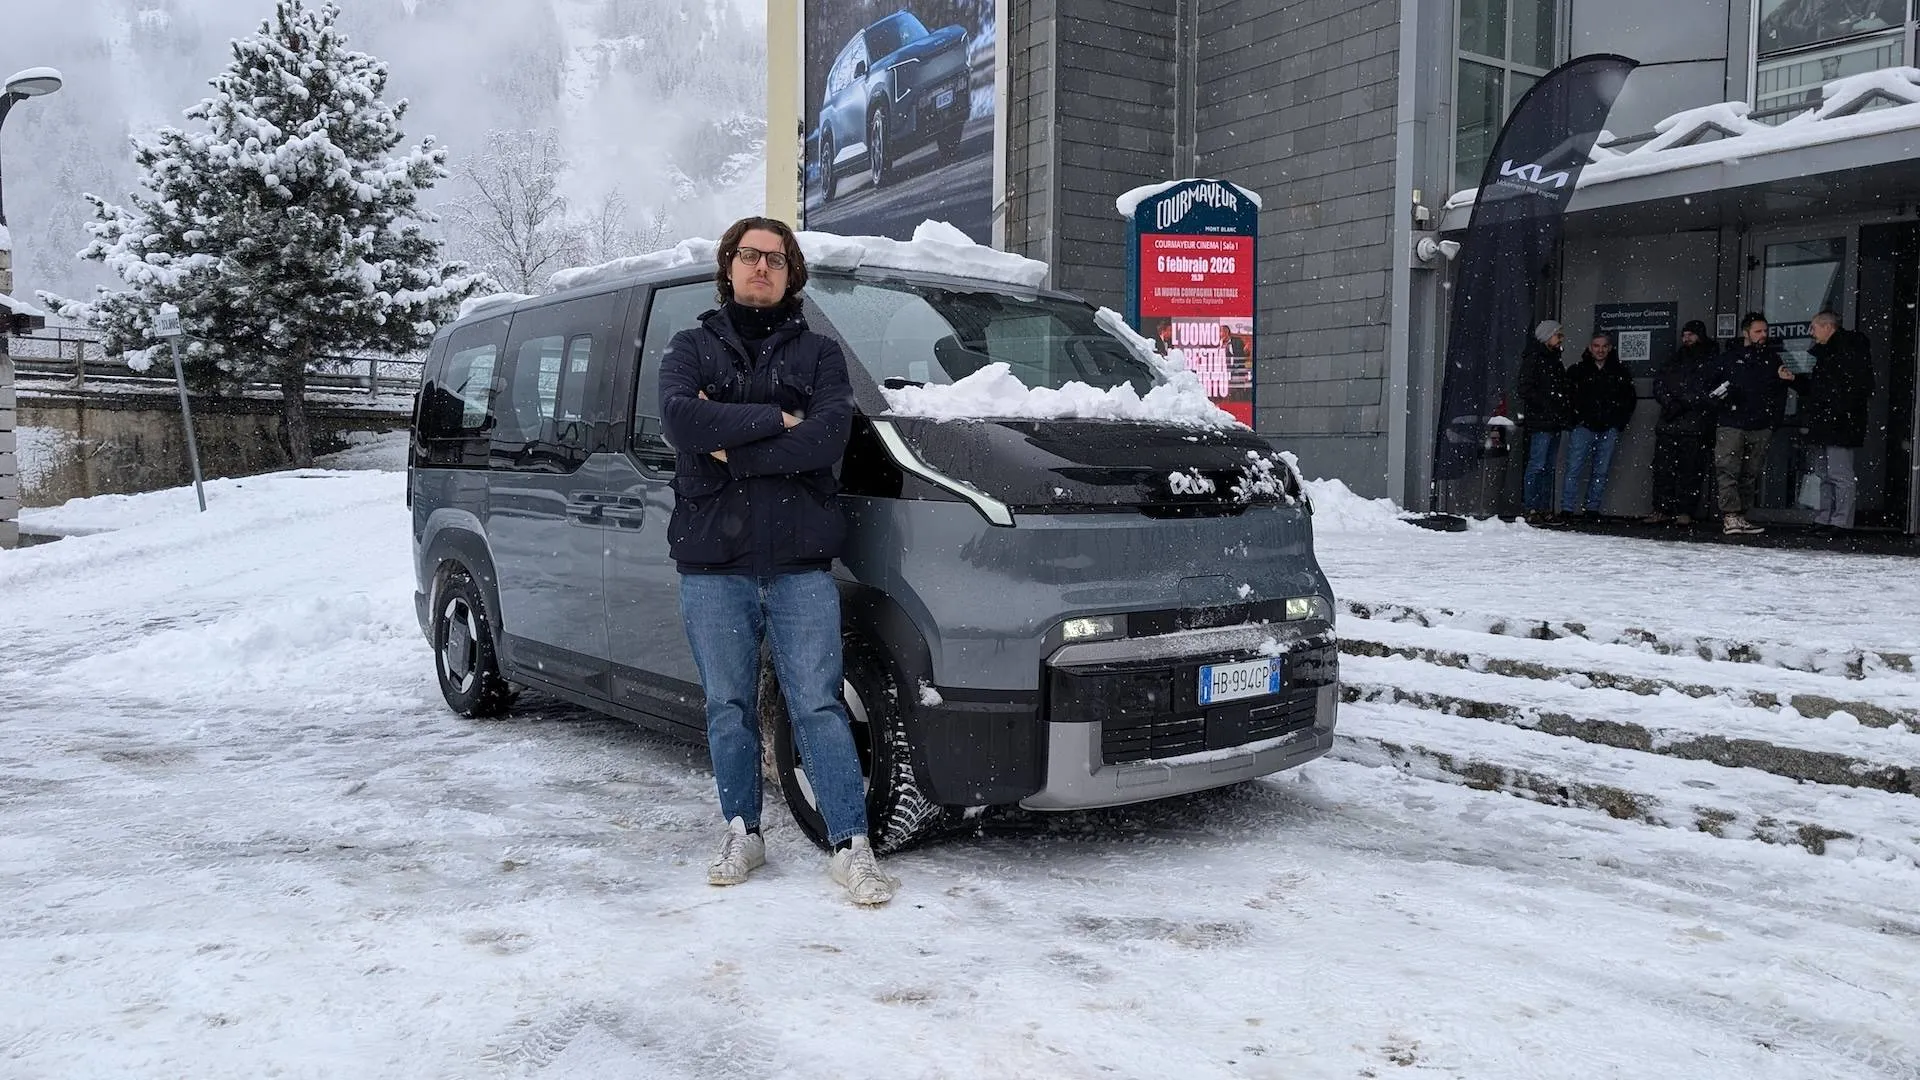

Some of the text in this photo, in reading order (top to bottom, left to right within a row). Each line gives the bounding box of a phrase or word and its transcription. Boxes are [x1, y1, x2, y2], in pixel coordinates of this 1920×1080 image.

[1500, 159, 1570, 188] KIA
[1156, 183, 1238, 230] COURMAYEUR
[1155, 240, 1196, 250] COURMAYEUR
[1196, 240, 1220, 250] CINEMA
[1223, 241, 1234, 250] Sala
[1157, 256, 1236, 274] 6 febbraio 2026
[1154, 287, 1161, 297] LA
[1181, 287, 1213, 298] COMPAGNIA
[1213, 288, 1239, 298] TEATRALE
